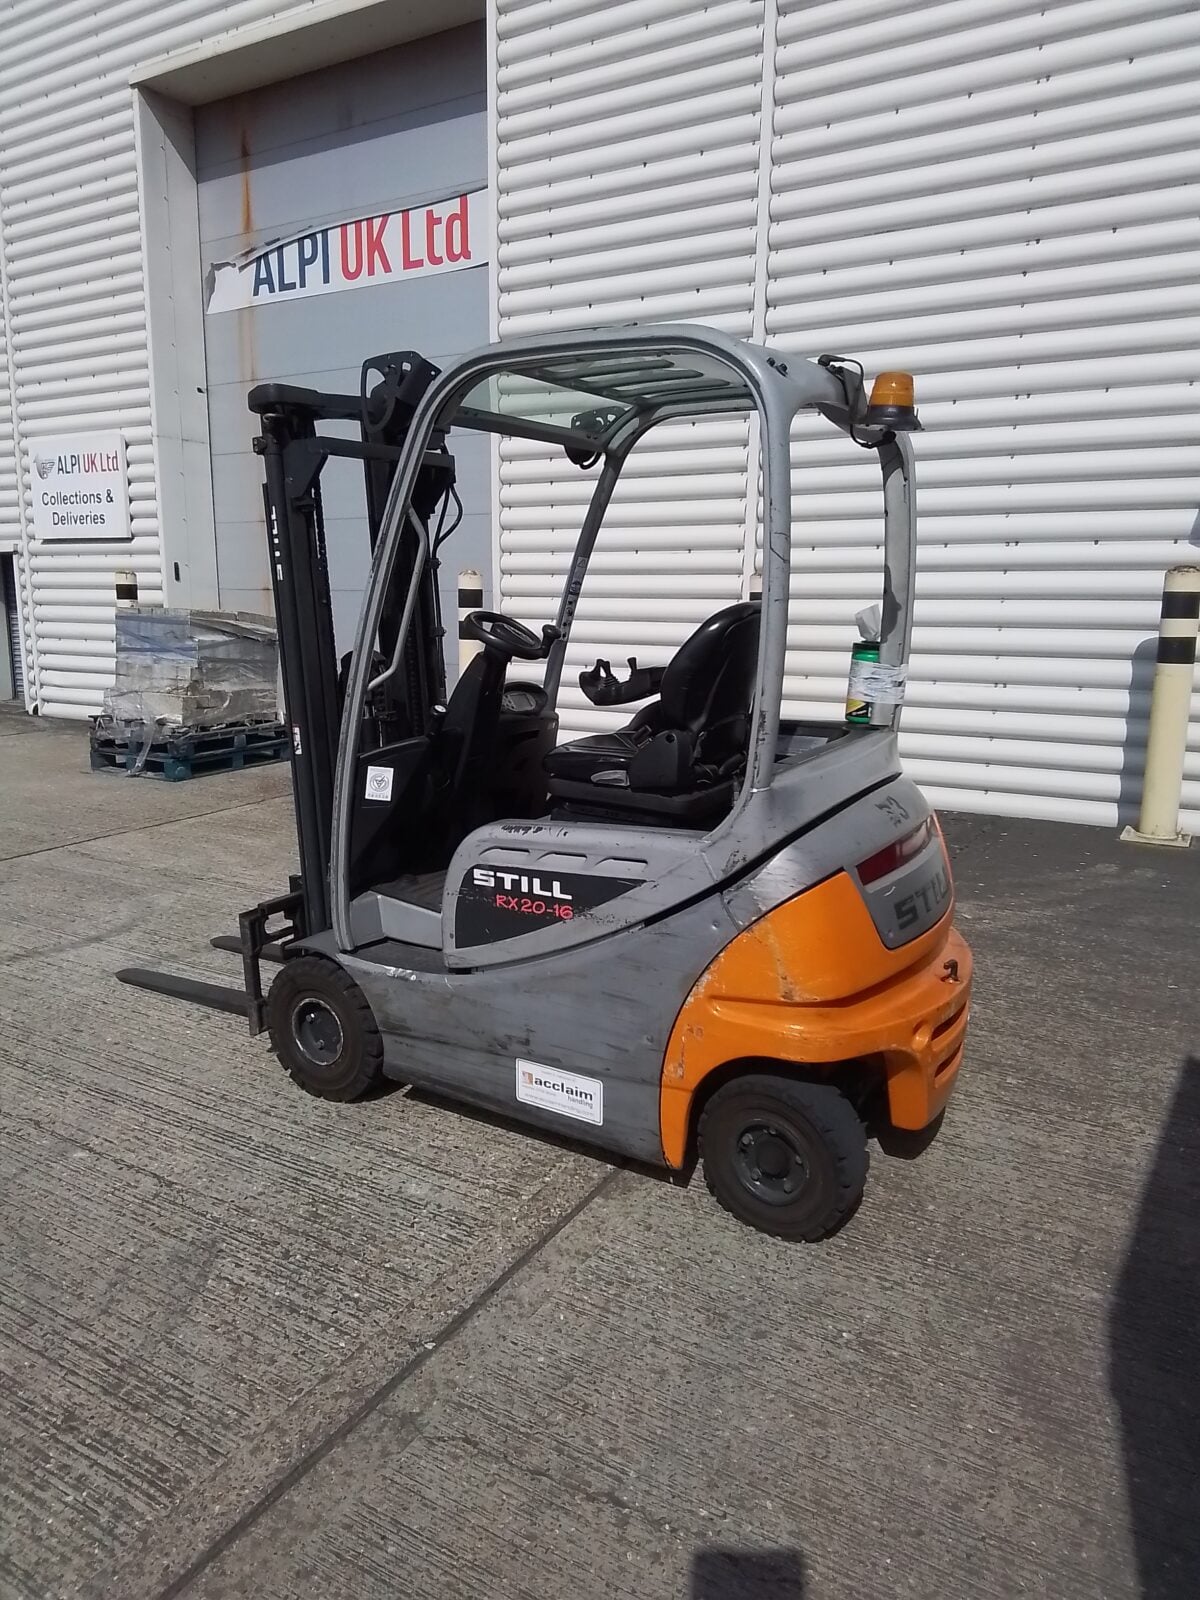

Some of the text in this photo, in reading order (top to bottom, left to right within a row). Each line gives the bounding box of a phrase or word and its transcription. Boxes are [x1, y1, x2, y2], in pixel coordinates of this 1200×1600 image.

[253, 193, 472, 297] ALPI UK Ltd
[57, 450, 119, 475] ALPI UK Ltd
[42, 488, 114, 506] Collections &
[52, 511, 106, 526] Deliveries
[473, 868, 573, 900] STILL
[534, 1077, 593, 1102] acclaim
